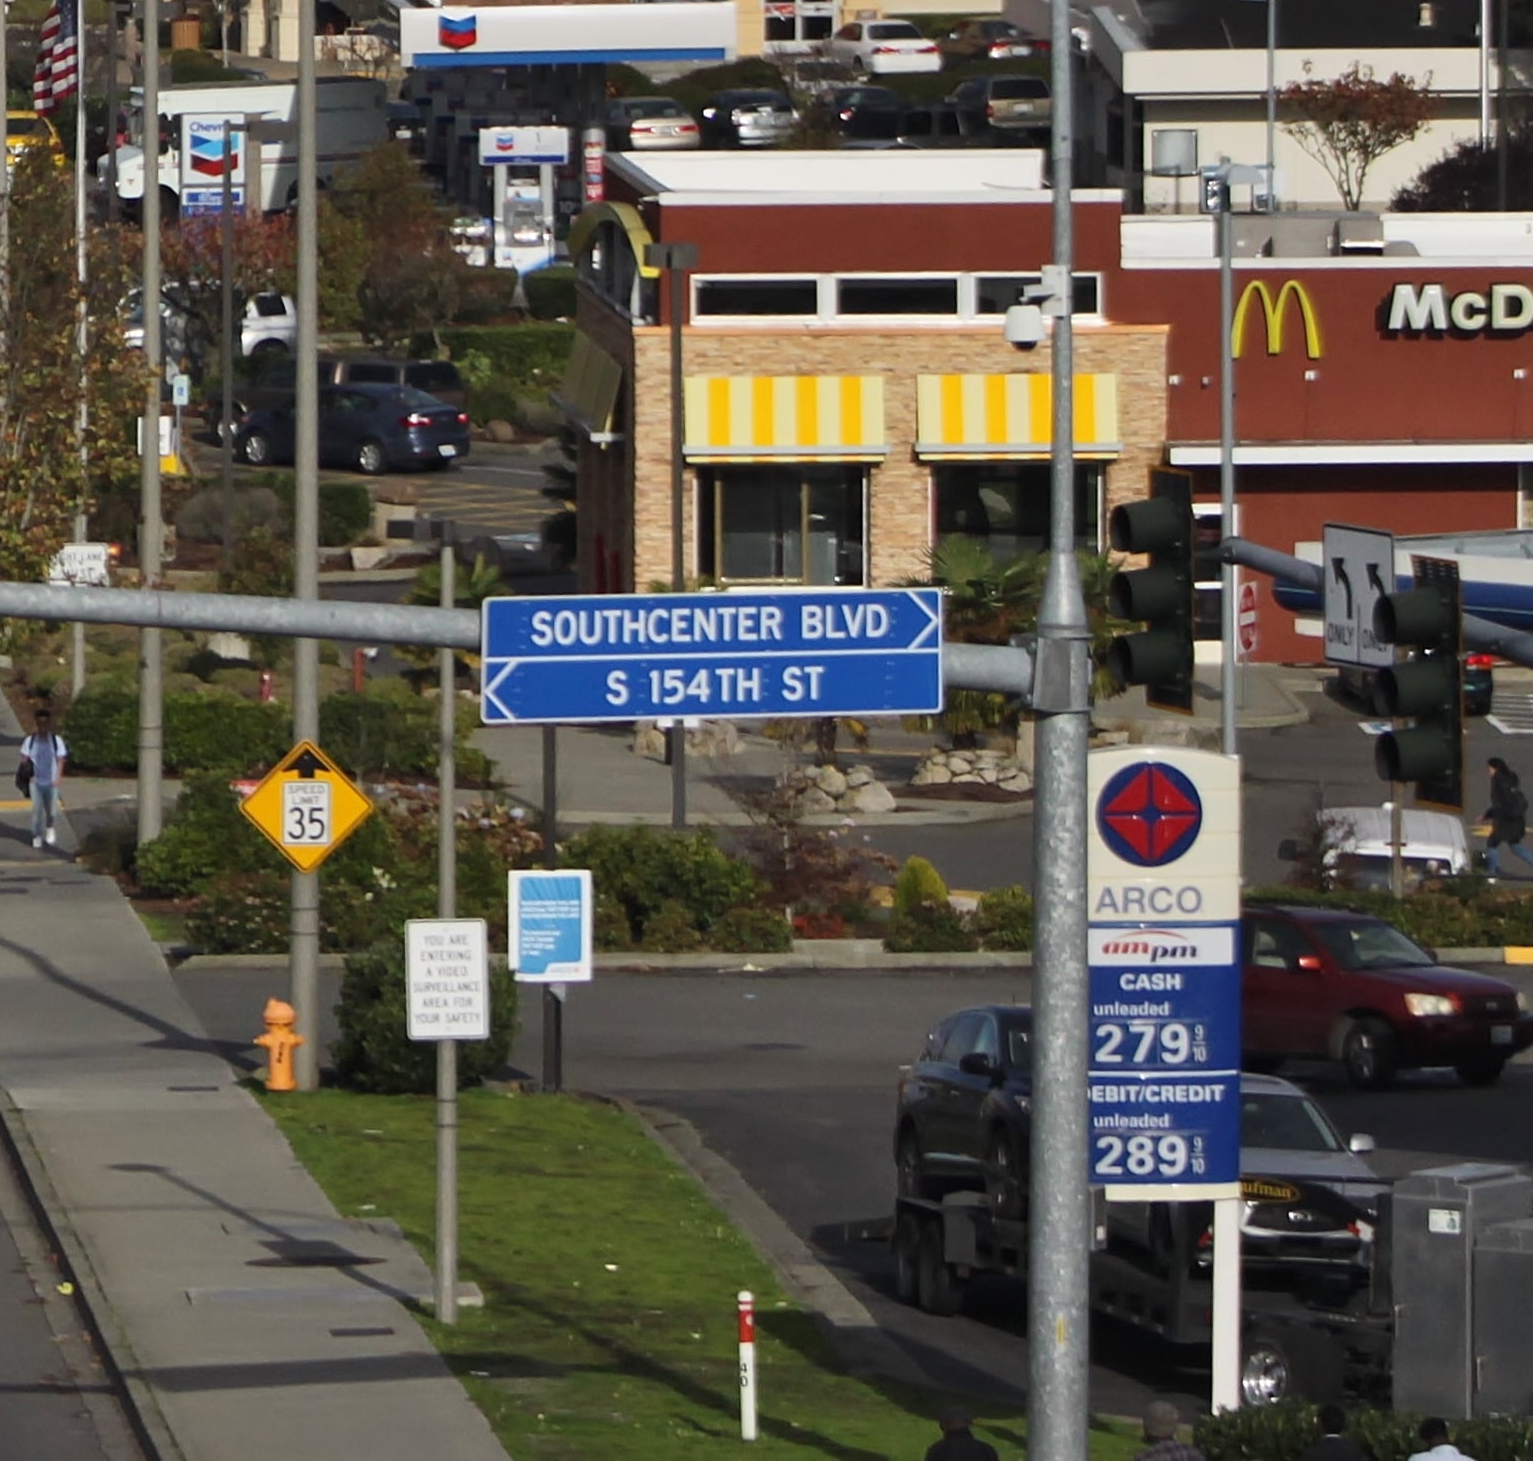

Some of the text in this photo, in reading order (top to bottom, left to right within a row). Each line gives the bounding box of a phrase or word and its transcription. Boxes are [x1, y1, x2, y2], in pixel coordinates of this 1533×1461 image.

[531, 604, 890, 647] SOUTHCENTER BLVD
[1327, 623, 1354, 646] ONLY
[605, 666, 824, 705] S 154TH ST
[288, 785, 325, 794] SPEED
[292, 796, 320, 805] LIMIT
[288, 807, 325, 840] 35
[1095, 886, 1202, 914] ARCO
[424, 934, 469, 945] YOU ARE
[421, 950, 471, 961] ENTERING
[438, 966, 467, 977] VIDEO
[413, 982, 481, 993] SURVEILLANCE
[1120, 973, 1182, 991] CASH
[423, 997, 473, 1007] AREA FOR
[1093, 1002, 1170, 1017] unleaded
[415, 1012, 481, 1024] YOUR SAFETY
[1088, 1085, 1225, 1103] EBIT/CREDIT
[1093, 1114, 1170, 1129] unleaded
